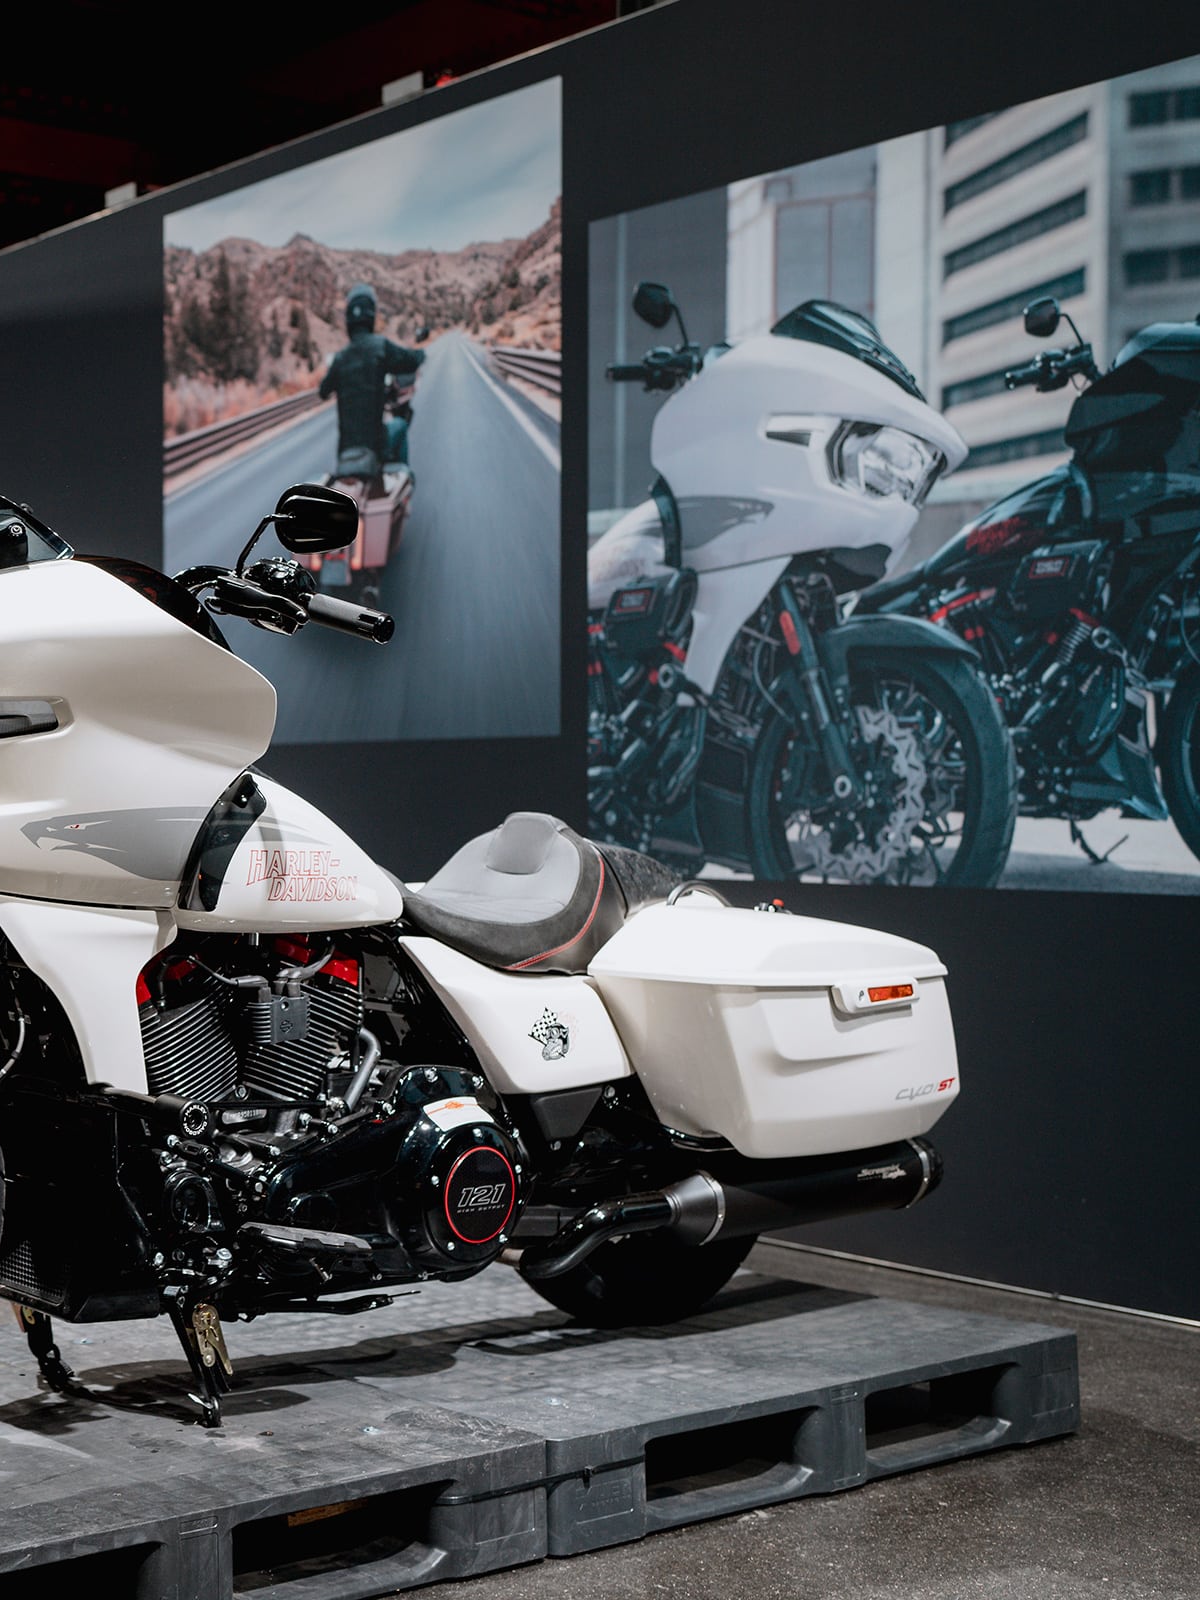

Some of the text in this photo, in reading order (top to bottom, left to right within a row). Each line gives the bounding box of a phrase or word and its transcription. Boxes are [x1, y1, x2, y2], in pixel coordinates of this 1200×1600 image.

[246, 849, 341, 885] HARLEY-
[268, 876, 358, 901] DAVIDSON
[457, 1183, 506, 1207] 121
